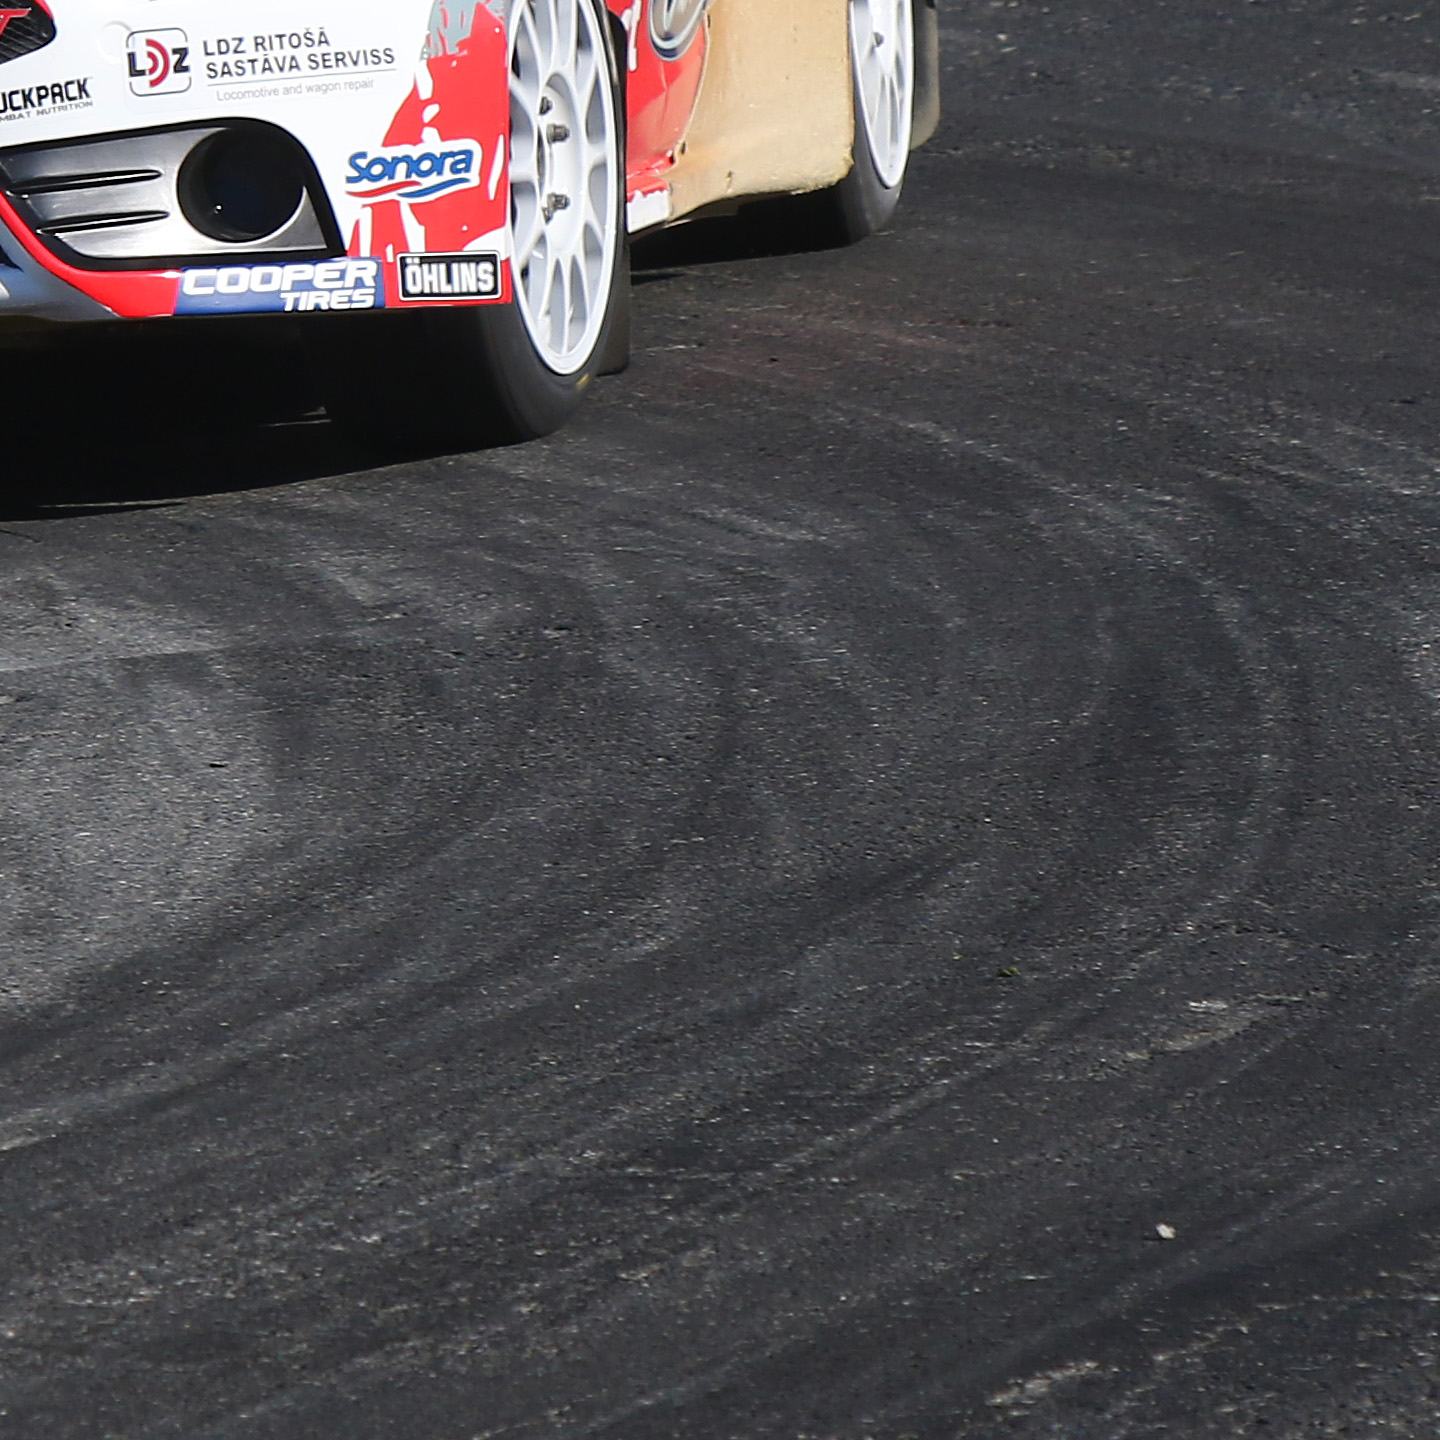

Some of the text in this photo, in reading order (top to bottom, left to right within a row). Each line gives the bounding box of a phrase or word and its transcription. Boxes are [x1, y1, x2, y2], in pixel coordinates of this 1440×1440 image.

[203, 27, 331, 56] LDZ RITOŠĀ
[206, 47, 395, 80] SASTĀVA SERVISS
[216, 77, 375, 102] Locomotive and wagon repair
[36, 100, 93, 117] NUTRITION
[345, 148, 474, 184] Sonora
[183, 261, 377, 296] COOPER
[404, 257, 496, 295] ÖHLINS
[280, 288, 376, 312] TIRES
